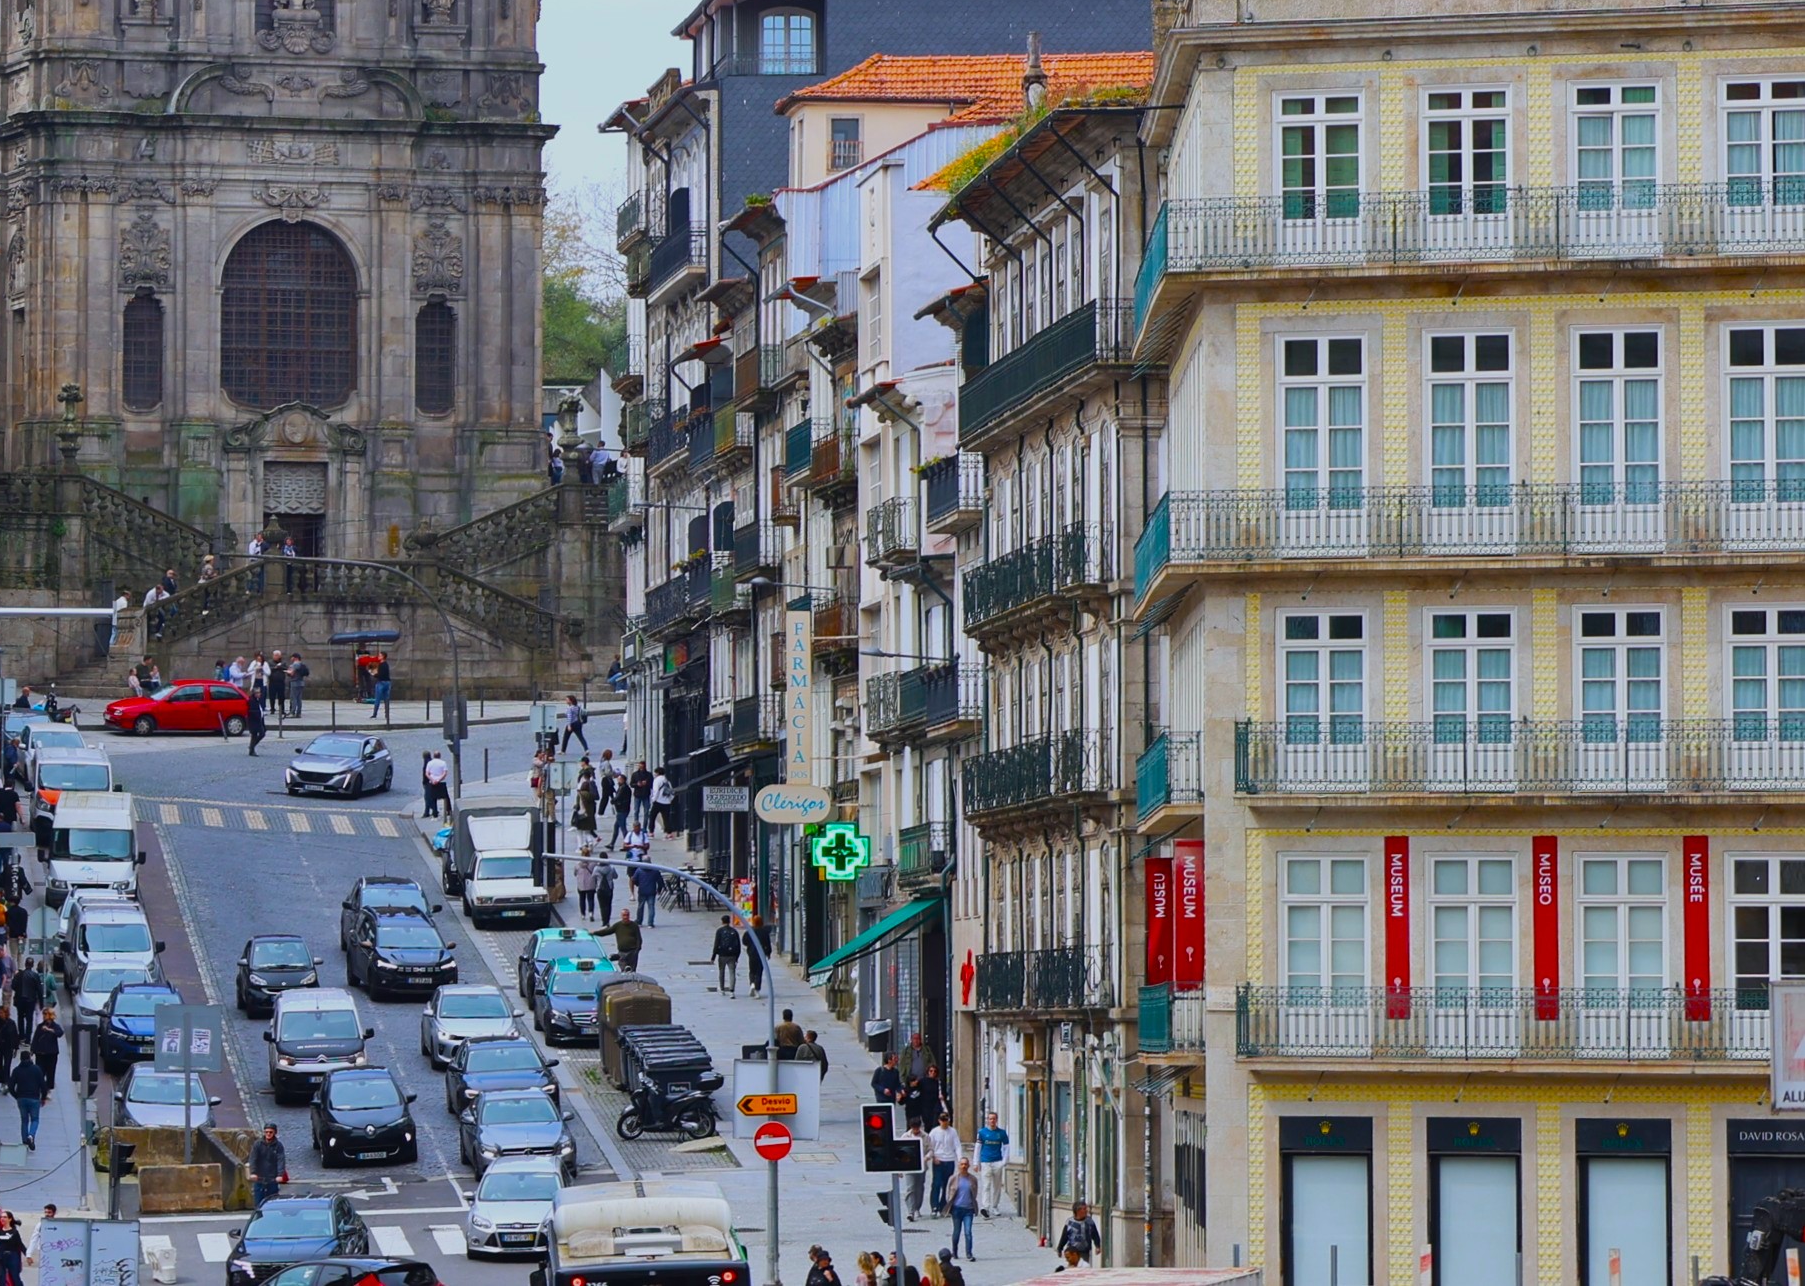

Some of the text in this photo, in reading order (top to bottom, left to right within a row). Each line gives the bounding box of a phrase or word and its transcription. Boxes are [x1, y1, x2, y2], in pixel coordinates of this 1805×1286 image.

[791, 621, 808, 764] FARMÁCIA
[791, 770, 808, 779] DOS
[761, 792, 826, 817] Clérigos
[1154, 873, 1167, 918] MUSEU
[1183, 855, 1197, 918] MUSEUM
[1390, 853, 1404, 917] MUSEUM
[1539, 853, 1552, 905] MUSEO
[1689, 853, 1705, 903] MUSÉE
[761, 1097, 791, 1105] Desvio
[1305, 1136, 1345, 1146] ROLEX
[1453, 1137, 1496, 1146] ROLEX
[1739, 1131, 1773, 1141] DAVID
